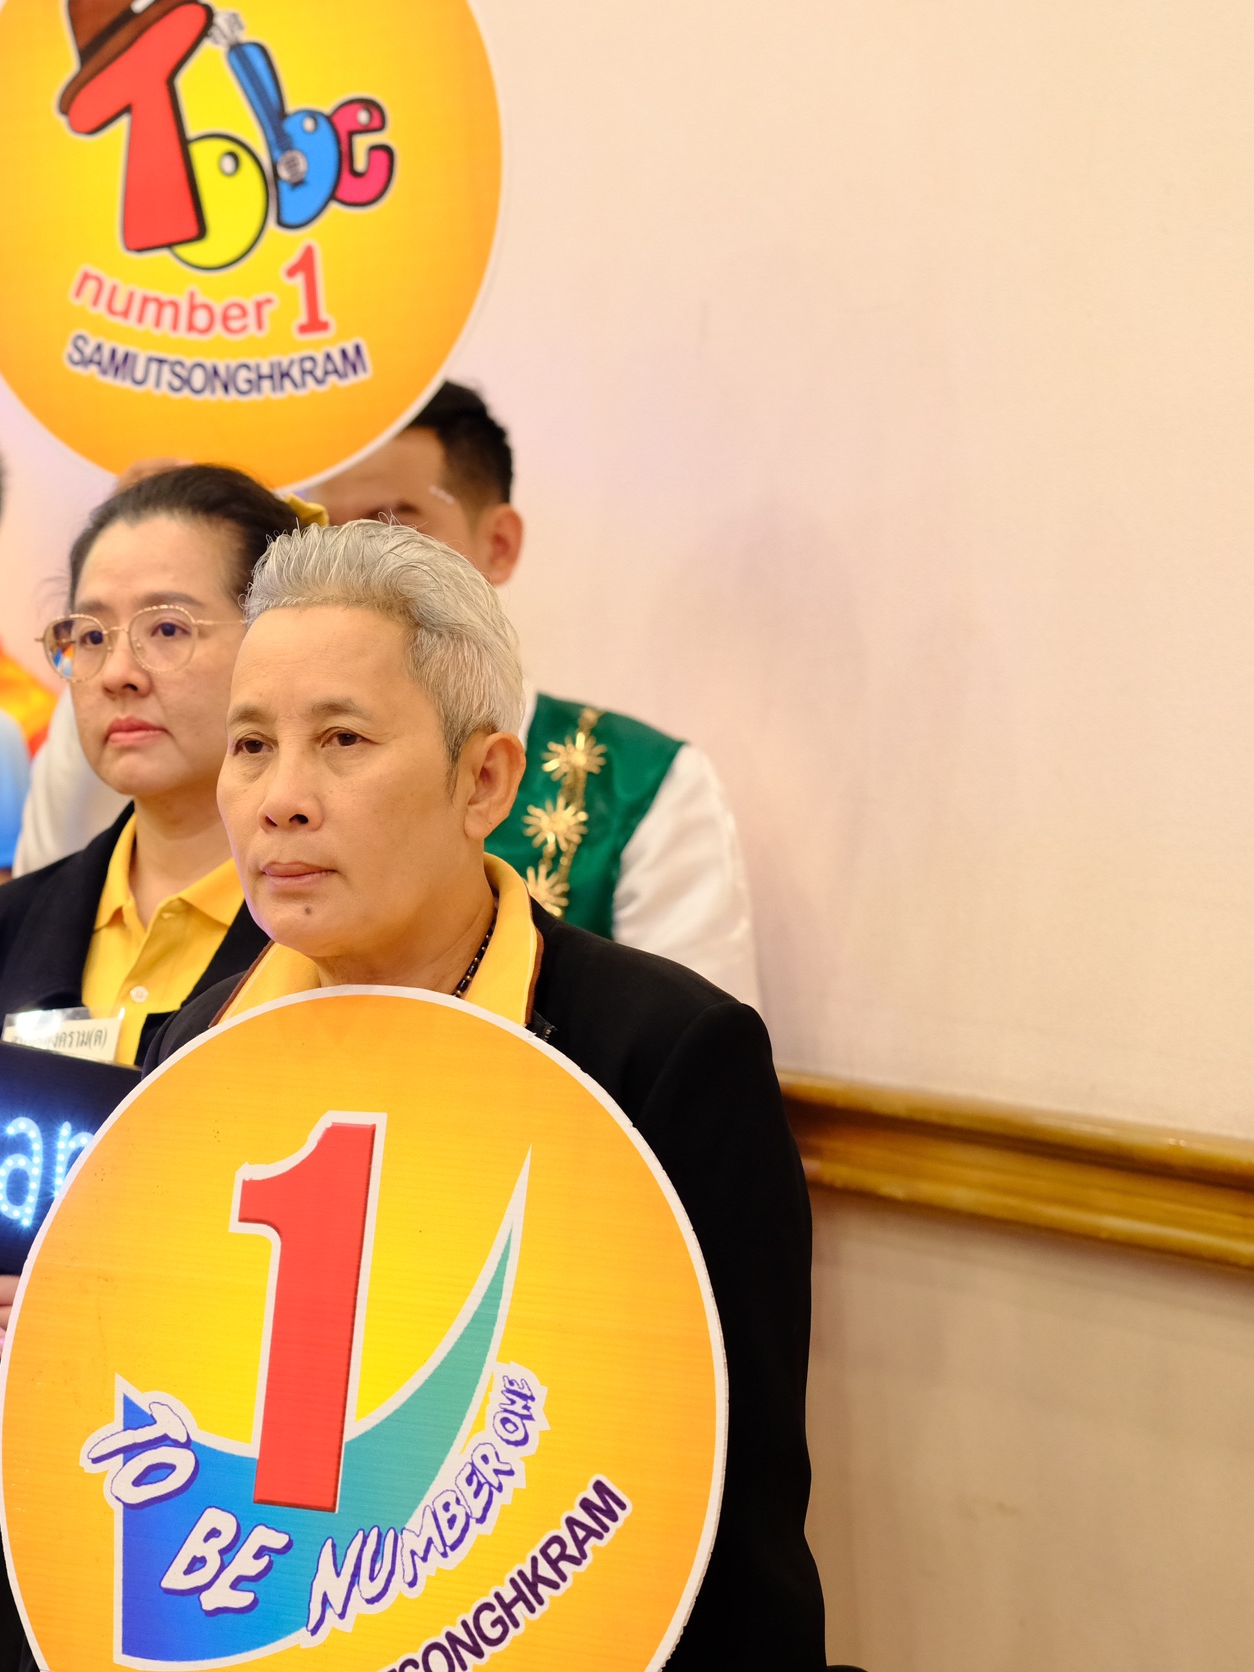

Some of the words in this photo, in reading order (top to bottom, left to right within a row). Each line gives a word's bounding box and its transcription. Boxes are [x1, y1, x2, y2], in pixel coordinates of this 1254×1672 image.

[67, 334, 369, 396] SAMUTSONGHKRAM
[73, 268, 273, 335] number
[285, 244, 331, 333] 1
[236, 1120, 378, 1512] 1
[87, 1402, 200, 1510] TO
[159, 1506, 294, 1617] BE
[306, 1442, 515, 1637] NUMBER
[492, 1375, 536, 1447] ONE
